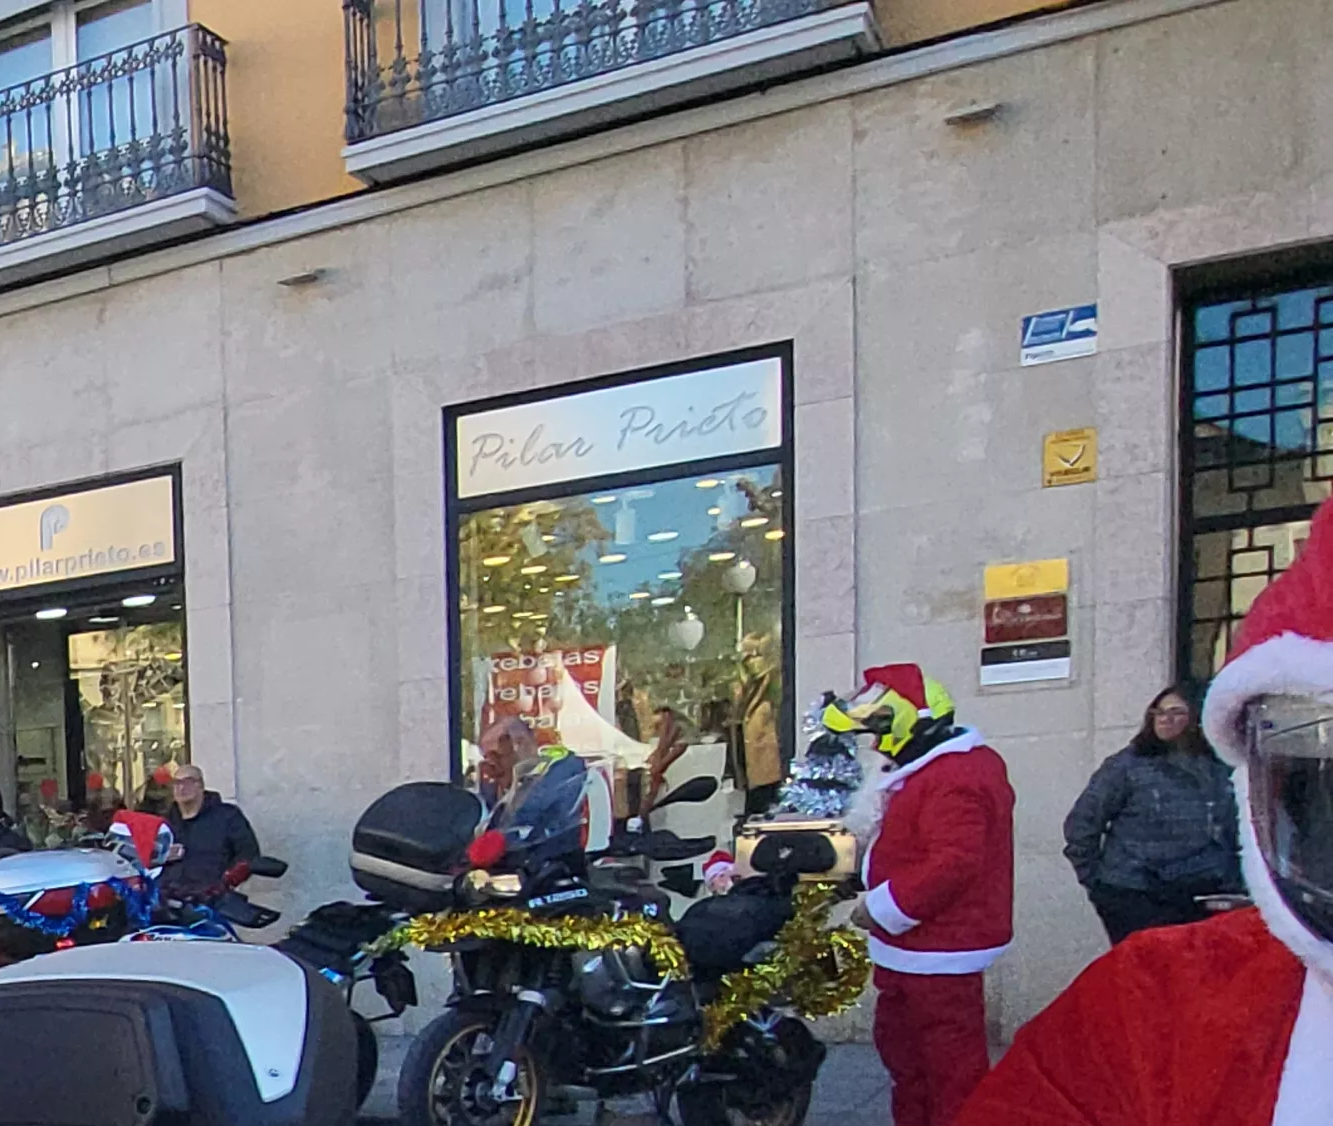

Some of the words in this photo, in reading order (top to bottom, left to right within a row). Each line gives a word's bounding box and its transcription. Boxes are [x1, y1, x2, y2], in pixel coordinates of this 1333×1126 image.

[469, 424, 594, 477] Pilar
[616, 390, 768, 450] Prieto
[490, 650, 600, 673] rebaas
